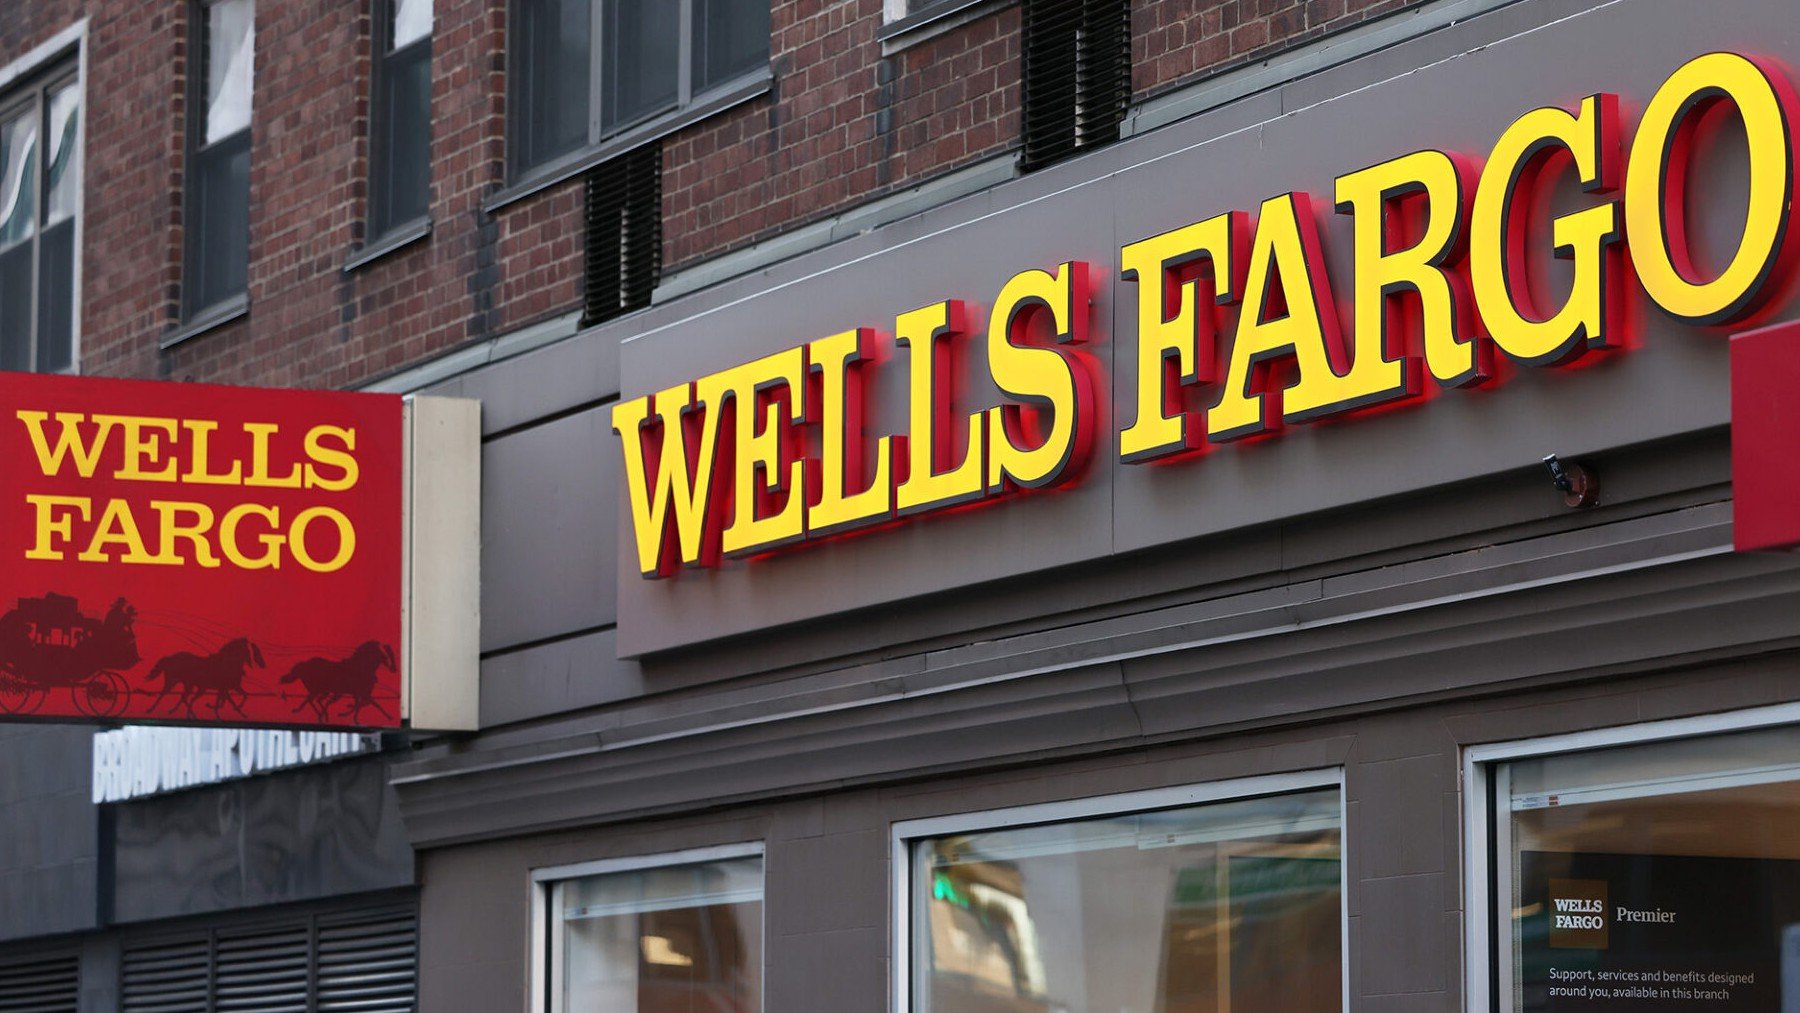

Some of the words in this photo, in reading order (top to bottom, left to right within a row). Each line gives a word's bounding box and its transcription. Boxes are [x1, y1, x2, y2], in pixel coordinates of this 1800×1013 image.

[611, 262, 1080, 576] WELLS
[1120, 52, 1790, 461] FARGO
[17, 410, 359, 492] WELLS
[25, 494, 356, 573] FARGO
[1554, 899, 1603, 913] WELLS
[1555, 915, 1604, 930] FARGO
[1616, 907, 1676, 923] Premier
[1549, 967, 1595, 982] Support,
[1597, 969, 1639, 981] services
[1641, 970, 1660, 982] and
[1662, 970, 1706, 983] benefits
[1708, 972, 1754, 986] designed
[1549, 985, 1587, 997] around
[1588, 987, 1611, 999] you,
[1612, 986, 1658, 998] available
[1660, 987, 1670, 998] in
[1672, 987, 1692, 999] this
[1694, 987, 1730, 1000] branch
